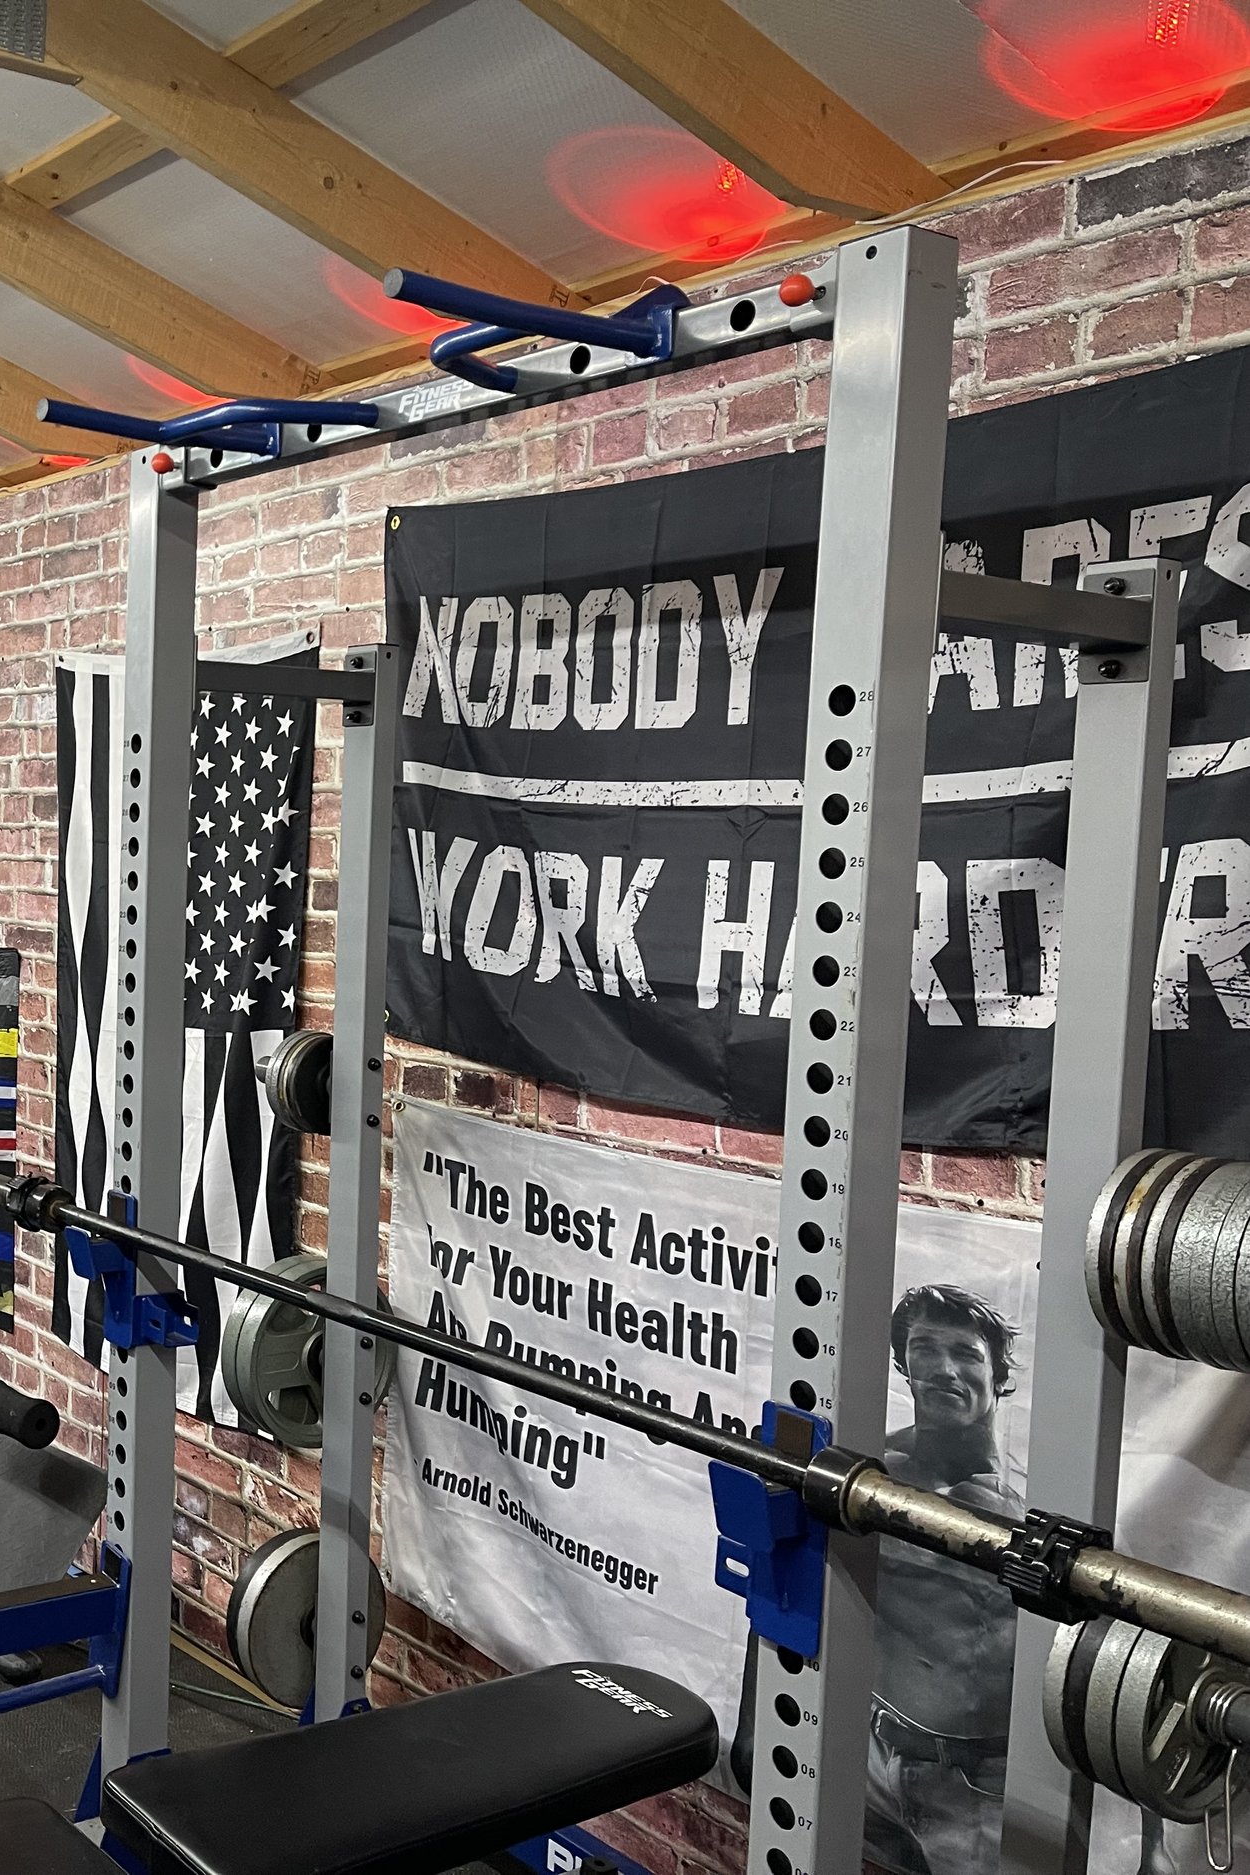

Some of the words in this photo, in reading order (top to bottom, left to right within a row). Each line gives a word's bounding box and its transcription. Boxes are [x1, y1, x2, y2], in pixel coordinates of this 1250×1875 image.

[398, 378, 475, 414] FITNESS
[408, 392, 462, 423] GEAR
[402, 567, 786, 731] NOBODY
[859, 690, 874, 702] 28
[856, 746, 871, 758] 27
[853, 801, 869, 813] 26
[849, 856, 865, 868] 25
[846, 911, 861, 923] 24
[408, 828, 665, 1003] WORK
[696, 838, 1250, 1031] HRDR
[840, 1020, 855, 1032] 22
[837, 1075, 851, 1087] 21
[831, 1183, 845, 1195] 19
[524, 1181, 616, 1258] Best
[630, 1212, 778, 1298] Activi
[825, 1290, 838, 1302] 17
[488, 1244, 573, 1321] Your
[587, 1277, 739, 1375] Health
[822, 1343, 836, 1356] 16
[819, 1397, 832, 1409] 15
[414, 1357, 606, 1490] Humping"
[422, 1457, 492, 1508] Arnold
[497, 1488, 659, 1595] Schwarzenegger
[571, 1668, 674, 1718] FITNESS
[575, 1678, 648, 1714] GEAR
[803, 1711, 818, 1725] 09
[801, 1763, 816, 1779] 08
[798, 1816, 813, 1831] 07
